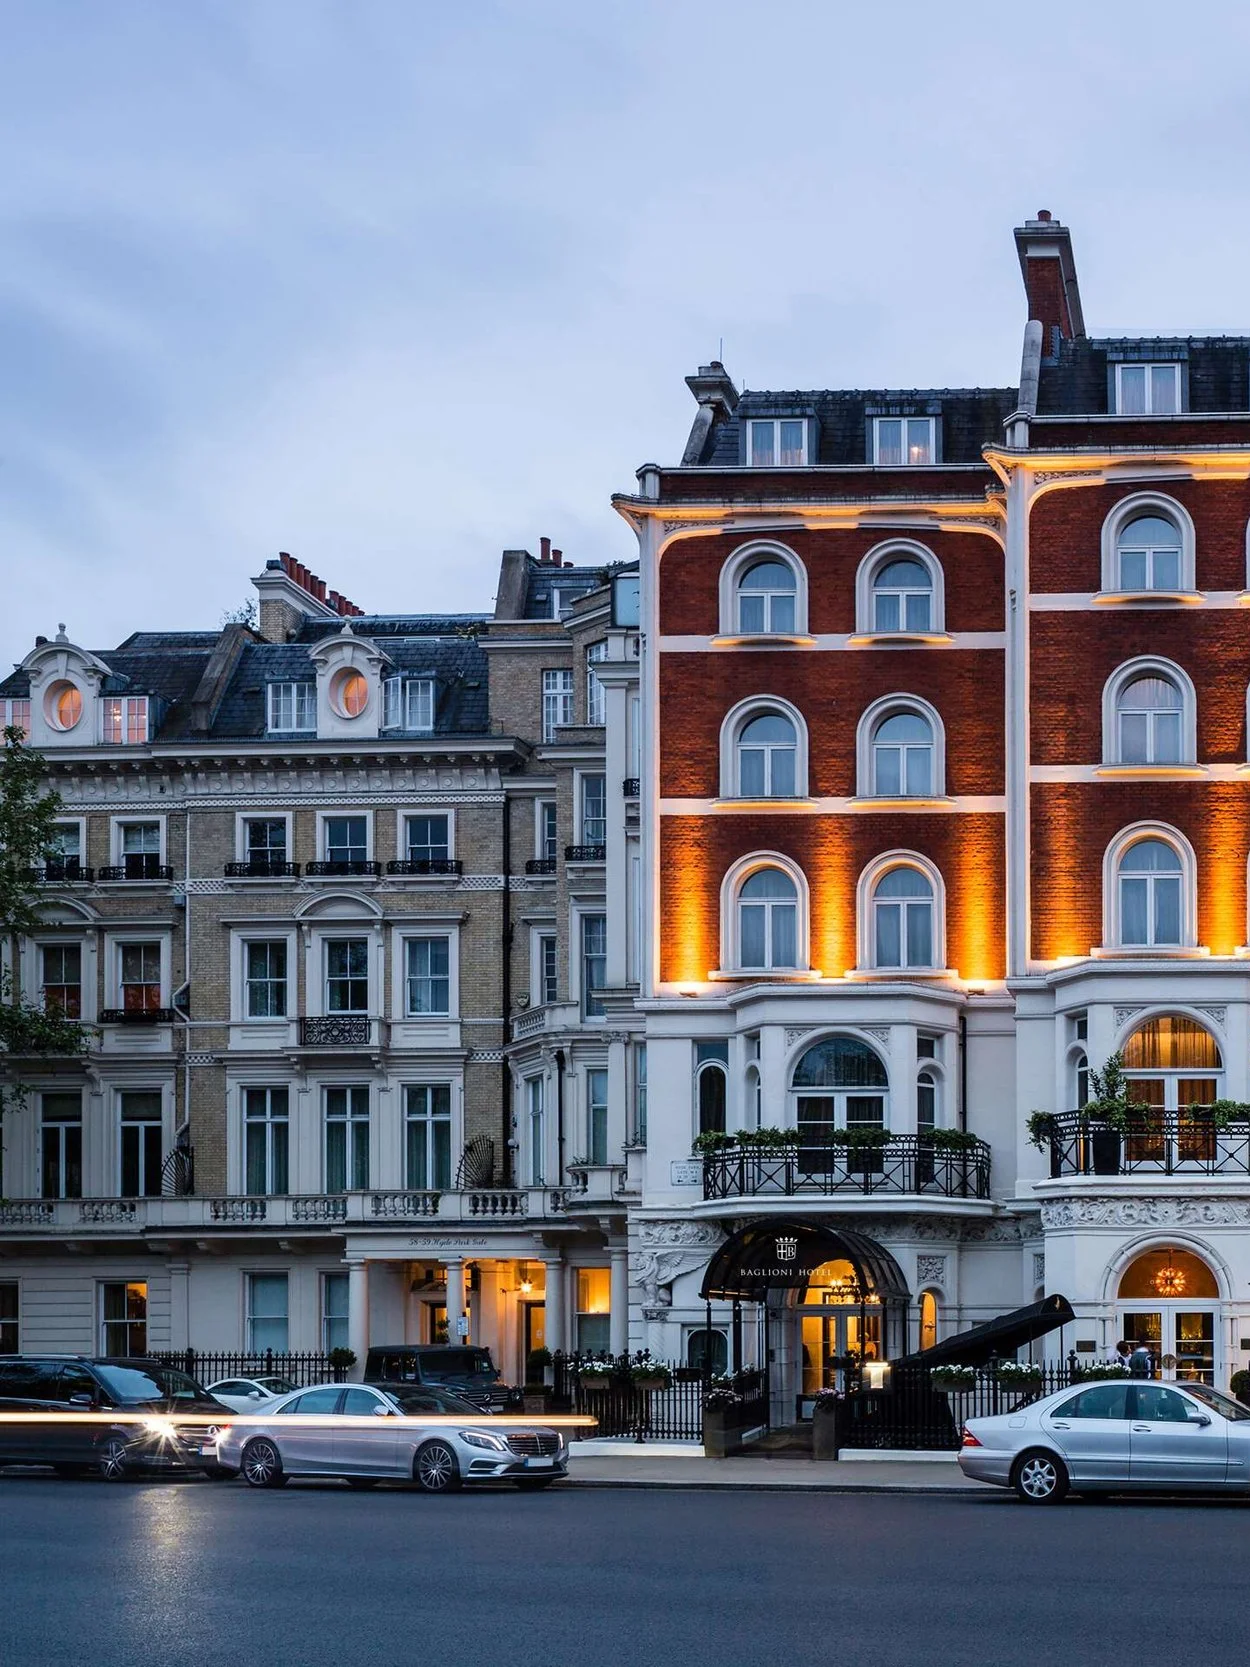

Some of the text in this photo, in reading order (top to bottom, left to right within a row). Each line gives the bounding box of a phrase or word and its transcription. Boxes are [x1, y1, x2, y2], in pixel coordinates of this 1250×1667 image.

[432, 1238, 452, 1248] Hyde
[740, 1268, 832, 1276] BAGLIONI HOTEL
